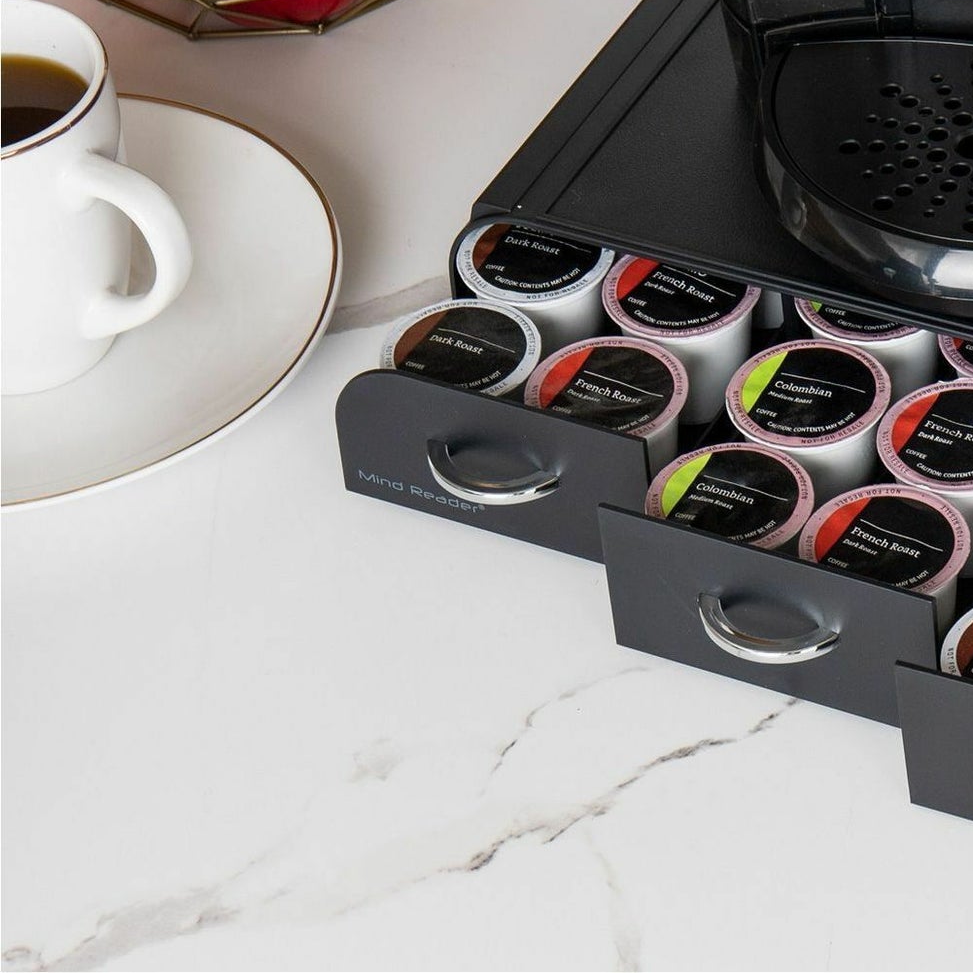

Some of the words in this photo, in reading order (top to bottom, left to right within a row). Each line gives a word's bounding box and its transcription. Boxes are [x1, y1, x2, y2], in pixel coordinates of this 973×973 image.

[505, 236, 529, 248] Dark
[531, 241, 560, 255] Roast
[485, 264, 505, 272] COFFEE
[551, 278, 563, 286] MAY
[570, 267, 580, 276] HOT
[644, 281, 658, 290] Dark
[657, 285, 675, 295] Roast
[653, 271, 686, 290] French
[686, 287, 715, 303] Roast
[627, 297, 648, 306] COFFEE
[825, 307, 846, 316] COFFEE
[656, 319, 686, 327] CONTENTS
[864, 322, 895, 331] CONTENTS
[429, 334, 454, 345] Dark
[454, 340, 483, 355] Roast
[405, 361, 425, 370] COFFEE
[469, 380, 482, 388] MAY
[482, 376, 490, 384] BE
[489, 370, 501, 380] HOT
[575, 378, 610, 397] French
[611, 391, 642, 404] Roast
[775, 380, 833, 398] Colombian
[768, 391, 794, 402] Medium
[794, 396, 813, 404] Roast
[756, 408, 778, 417] COFFEE
[825, 422, 837, 431] MAY
[844, 412, 856, 422] HOT
[924, 420, 963, 438] French
[918, 431, 936, 441] Dark
[935, 436, 953, 445] Roast
[905, 448, 928, 459] COFFEE
[359, 470, 404, 491] Mind
[688, 494, 714, 504] Medium
[714, 500, 733, 510] Roast
[696, 483, 754, 505] Colombian
[675, 512, 696, 520] COFFEE
[745, 531, 757, 539] MAY
[764, 520, 776, 530] HOT
[843, 539, 859, 548] Dark
[858, 543, 878, 555] Roast
[851, 526, 889, 548] French
[889, 543, 921, 559] Roast
[827, 557, 849, 568] COFFEE
[909, 575, 917, 584] BE
[916, 570, 929, 580] HOT
